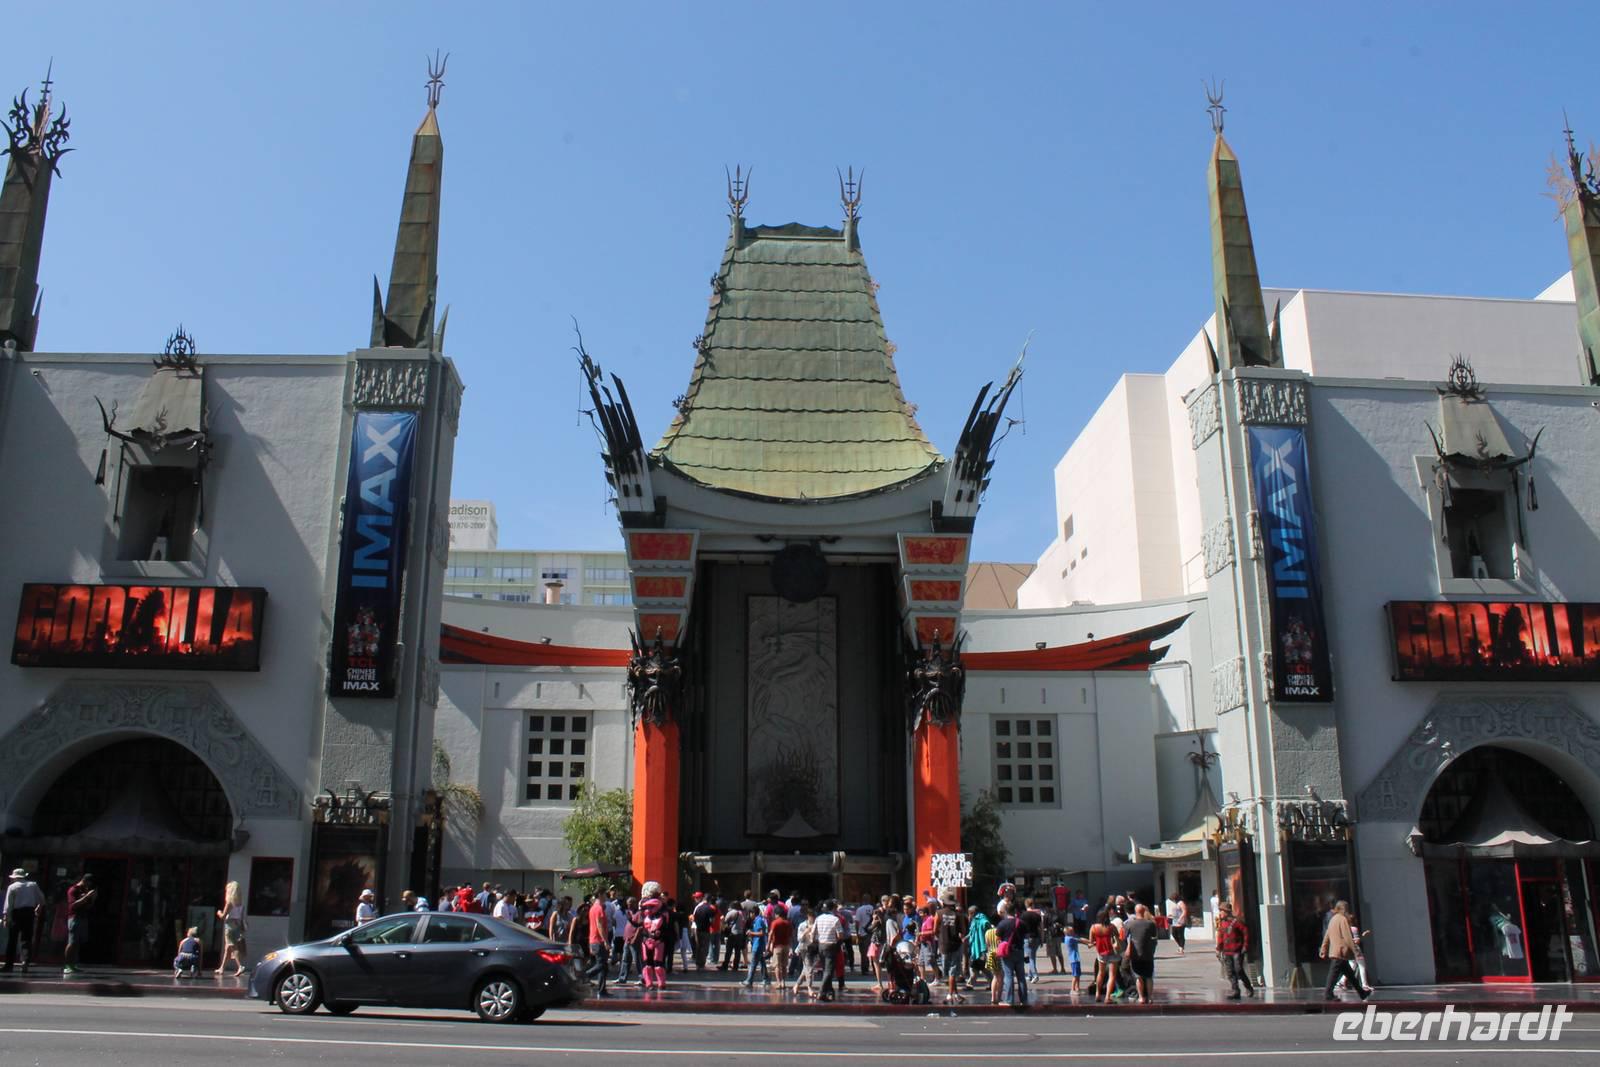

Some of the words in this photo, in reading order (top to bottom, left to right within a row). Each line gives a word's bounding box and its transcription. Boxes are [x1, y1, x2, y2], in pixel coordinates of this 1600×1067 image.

[351, 422, 401, 589] IMAX
[1260, 438, 1309, 599] IMAX
[17, 583, 254, 654] GODZILLA
[343, 681, 380, 690] IMAX
[1285, 687, 1320, 695] IMAX
